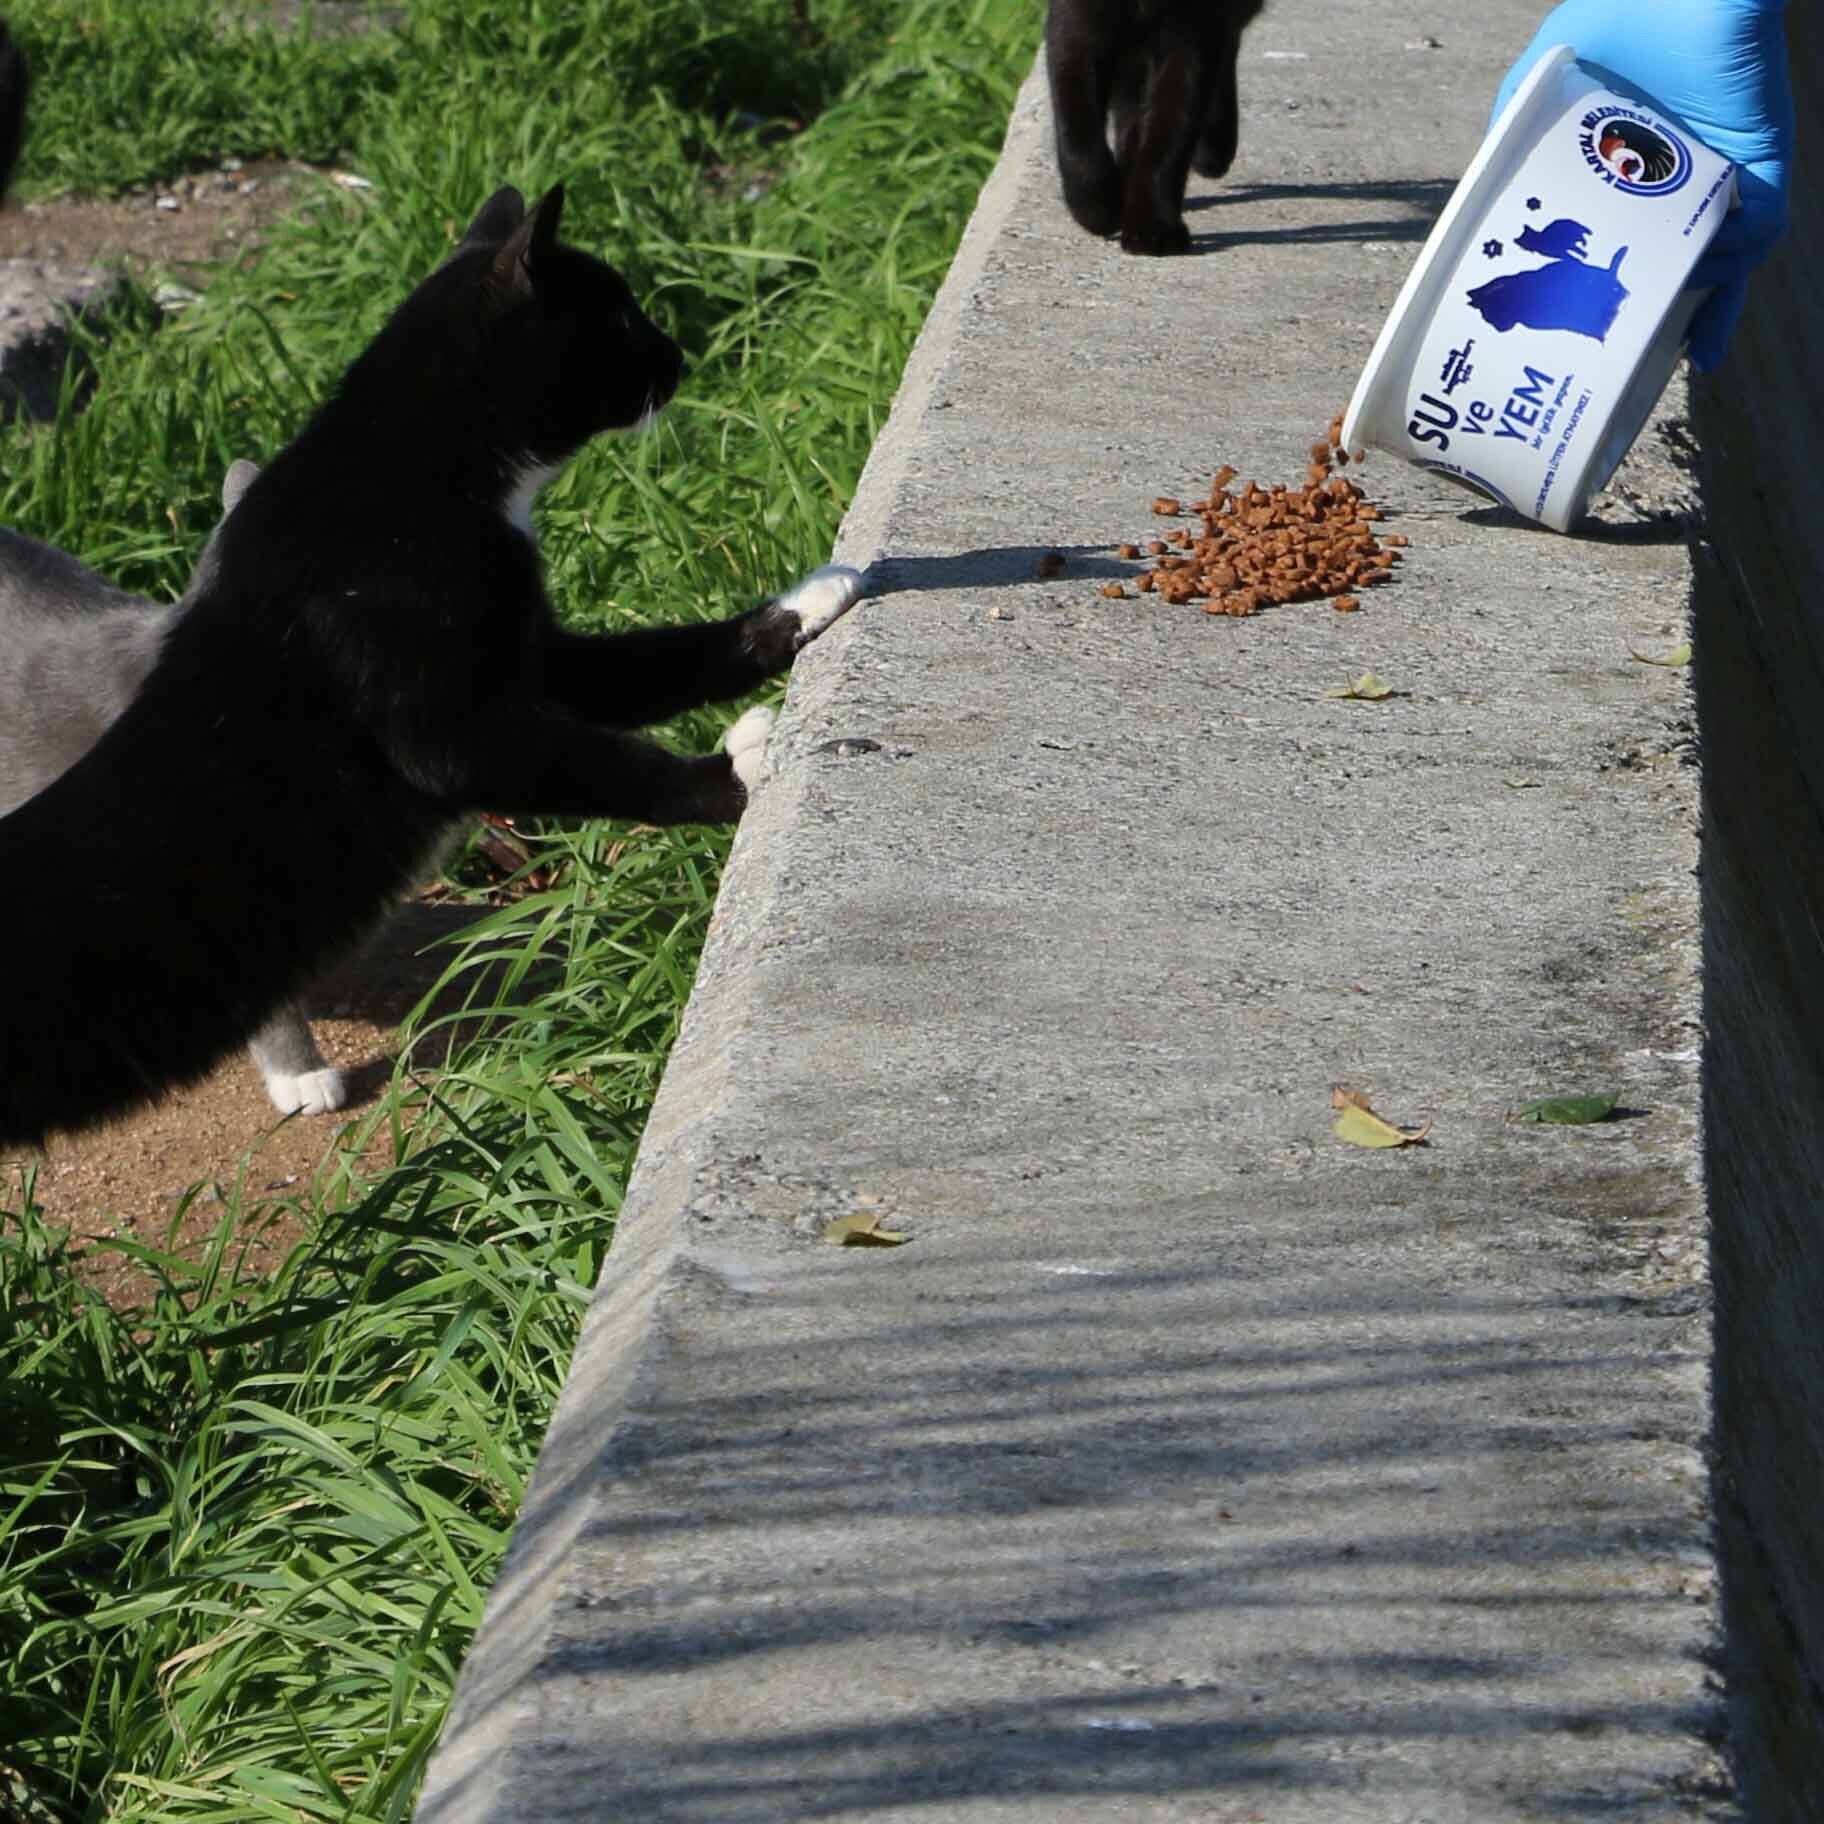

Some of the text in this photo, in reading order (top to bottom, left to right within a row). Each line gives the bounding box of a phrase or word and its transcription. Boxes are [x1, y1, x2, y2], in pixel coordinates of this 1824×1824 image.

[1579, 133, 1616, 184] KARTAL
[1407, 393, 1459, 452] SU
[1460, 400, 1495, 435] ve
[1493, 365, 1556, 442] YEM
